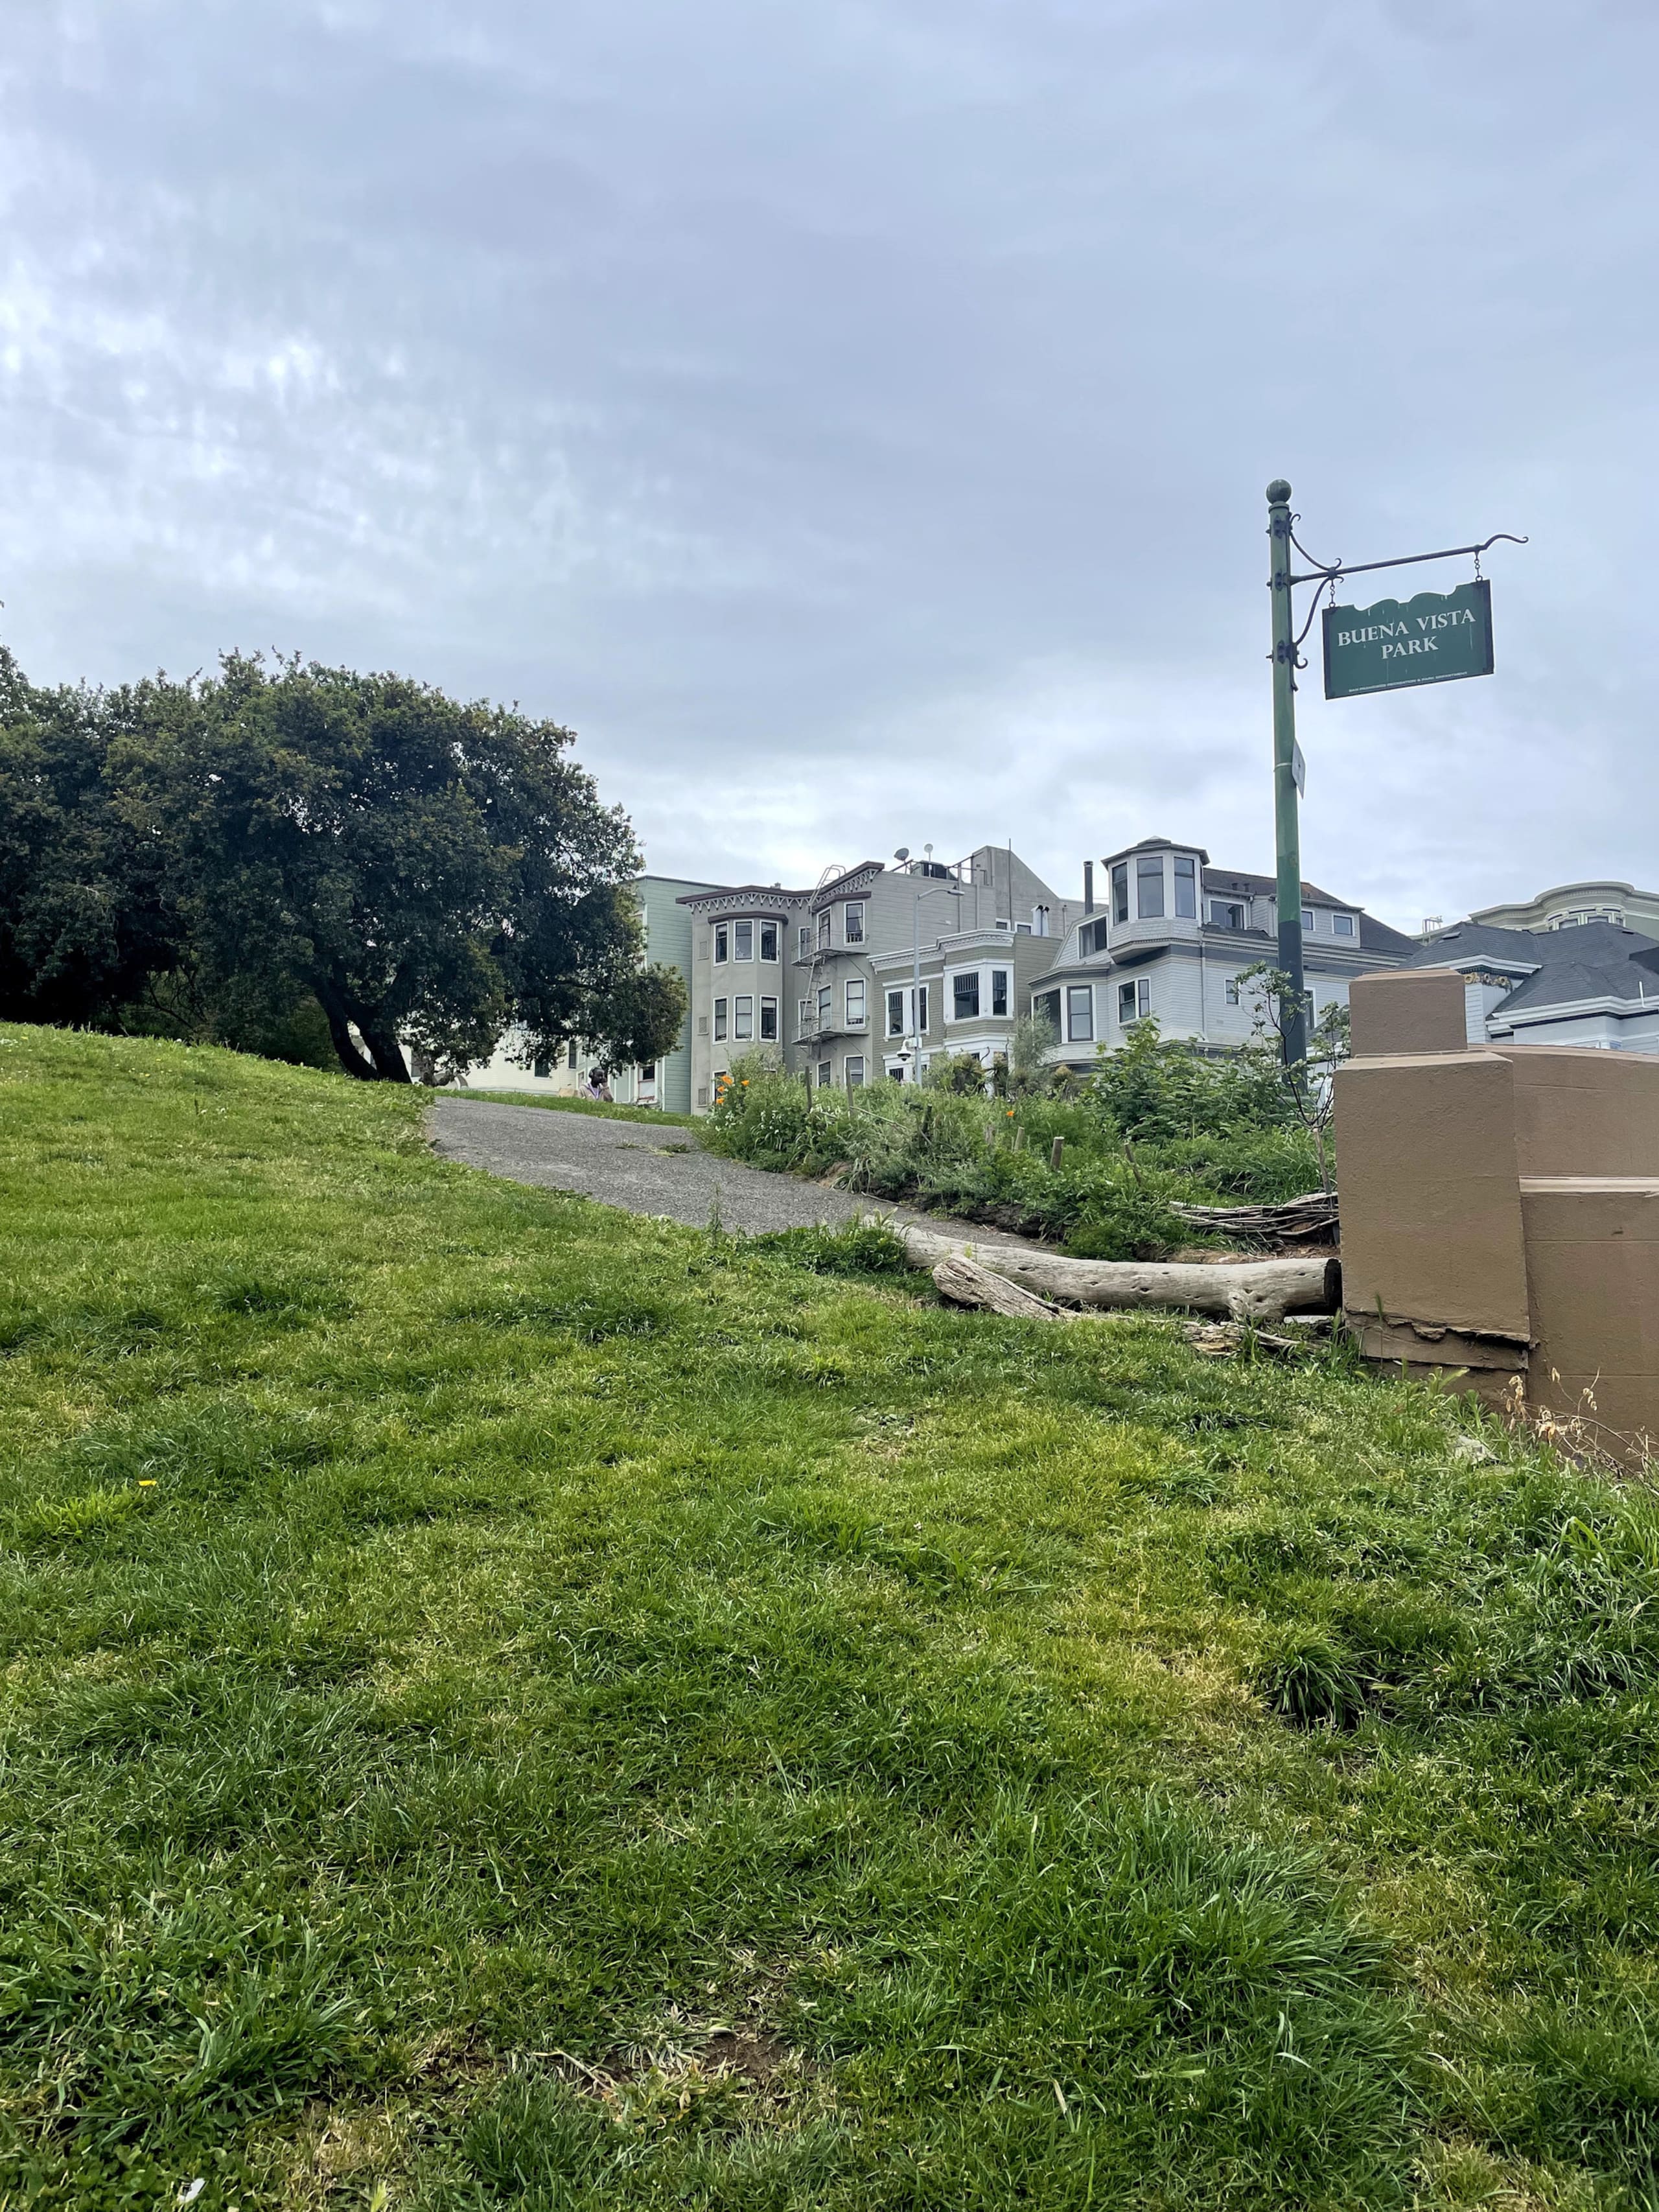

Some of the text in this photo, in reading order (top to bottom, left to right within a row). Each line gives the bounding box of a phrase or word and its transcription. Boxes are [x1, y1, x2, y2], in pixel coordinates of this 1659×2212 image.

[1338, 609, 1476, 646] BUENA VISTA
[1381, 636, 1439, 660] PARK
